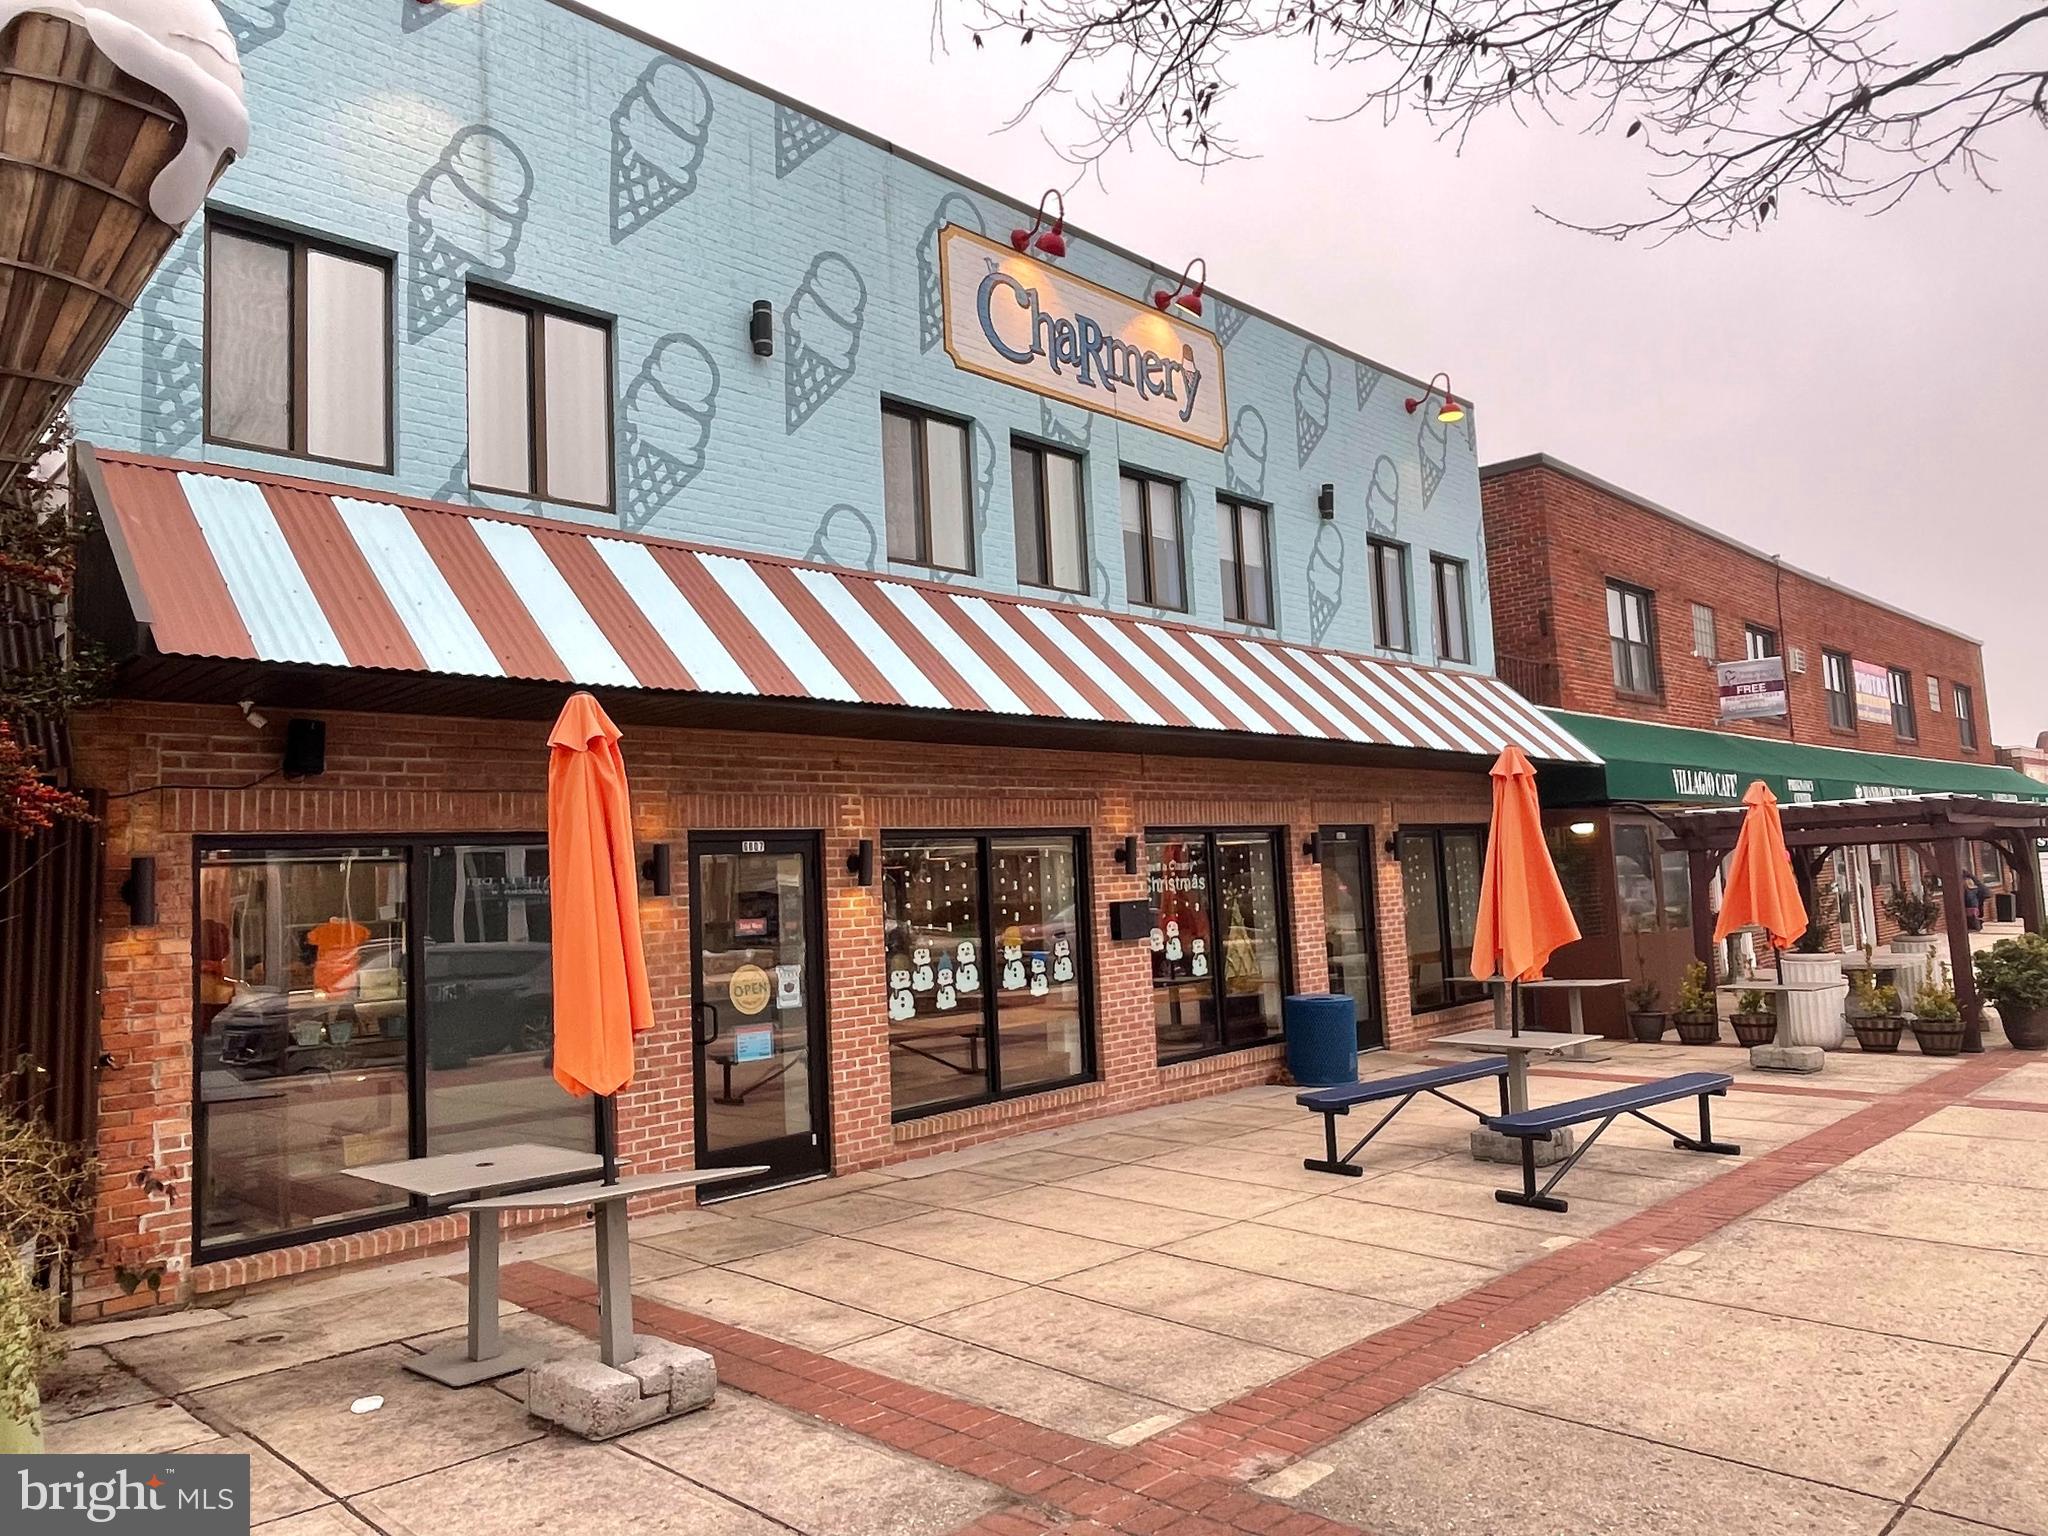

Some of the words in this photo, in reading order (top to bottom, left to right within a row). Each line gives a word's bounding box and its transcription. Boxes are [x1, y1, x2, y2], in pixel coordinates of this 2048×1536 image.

[1736, 682, 1767, 695] FREE
[1671, 768, 1715, 796] VILLAGIO
[733, 981, 769, 998] OPEN
